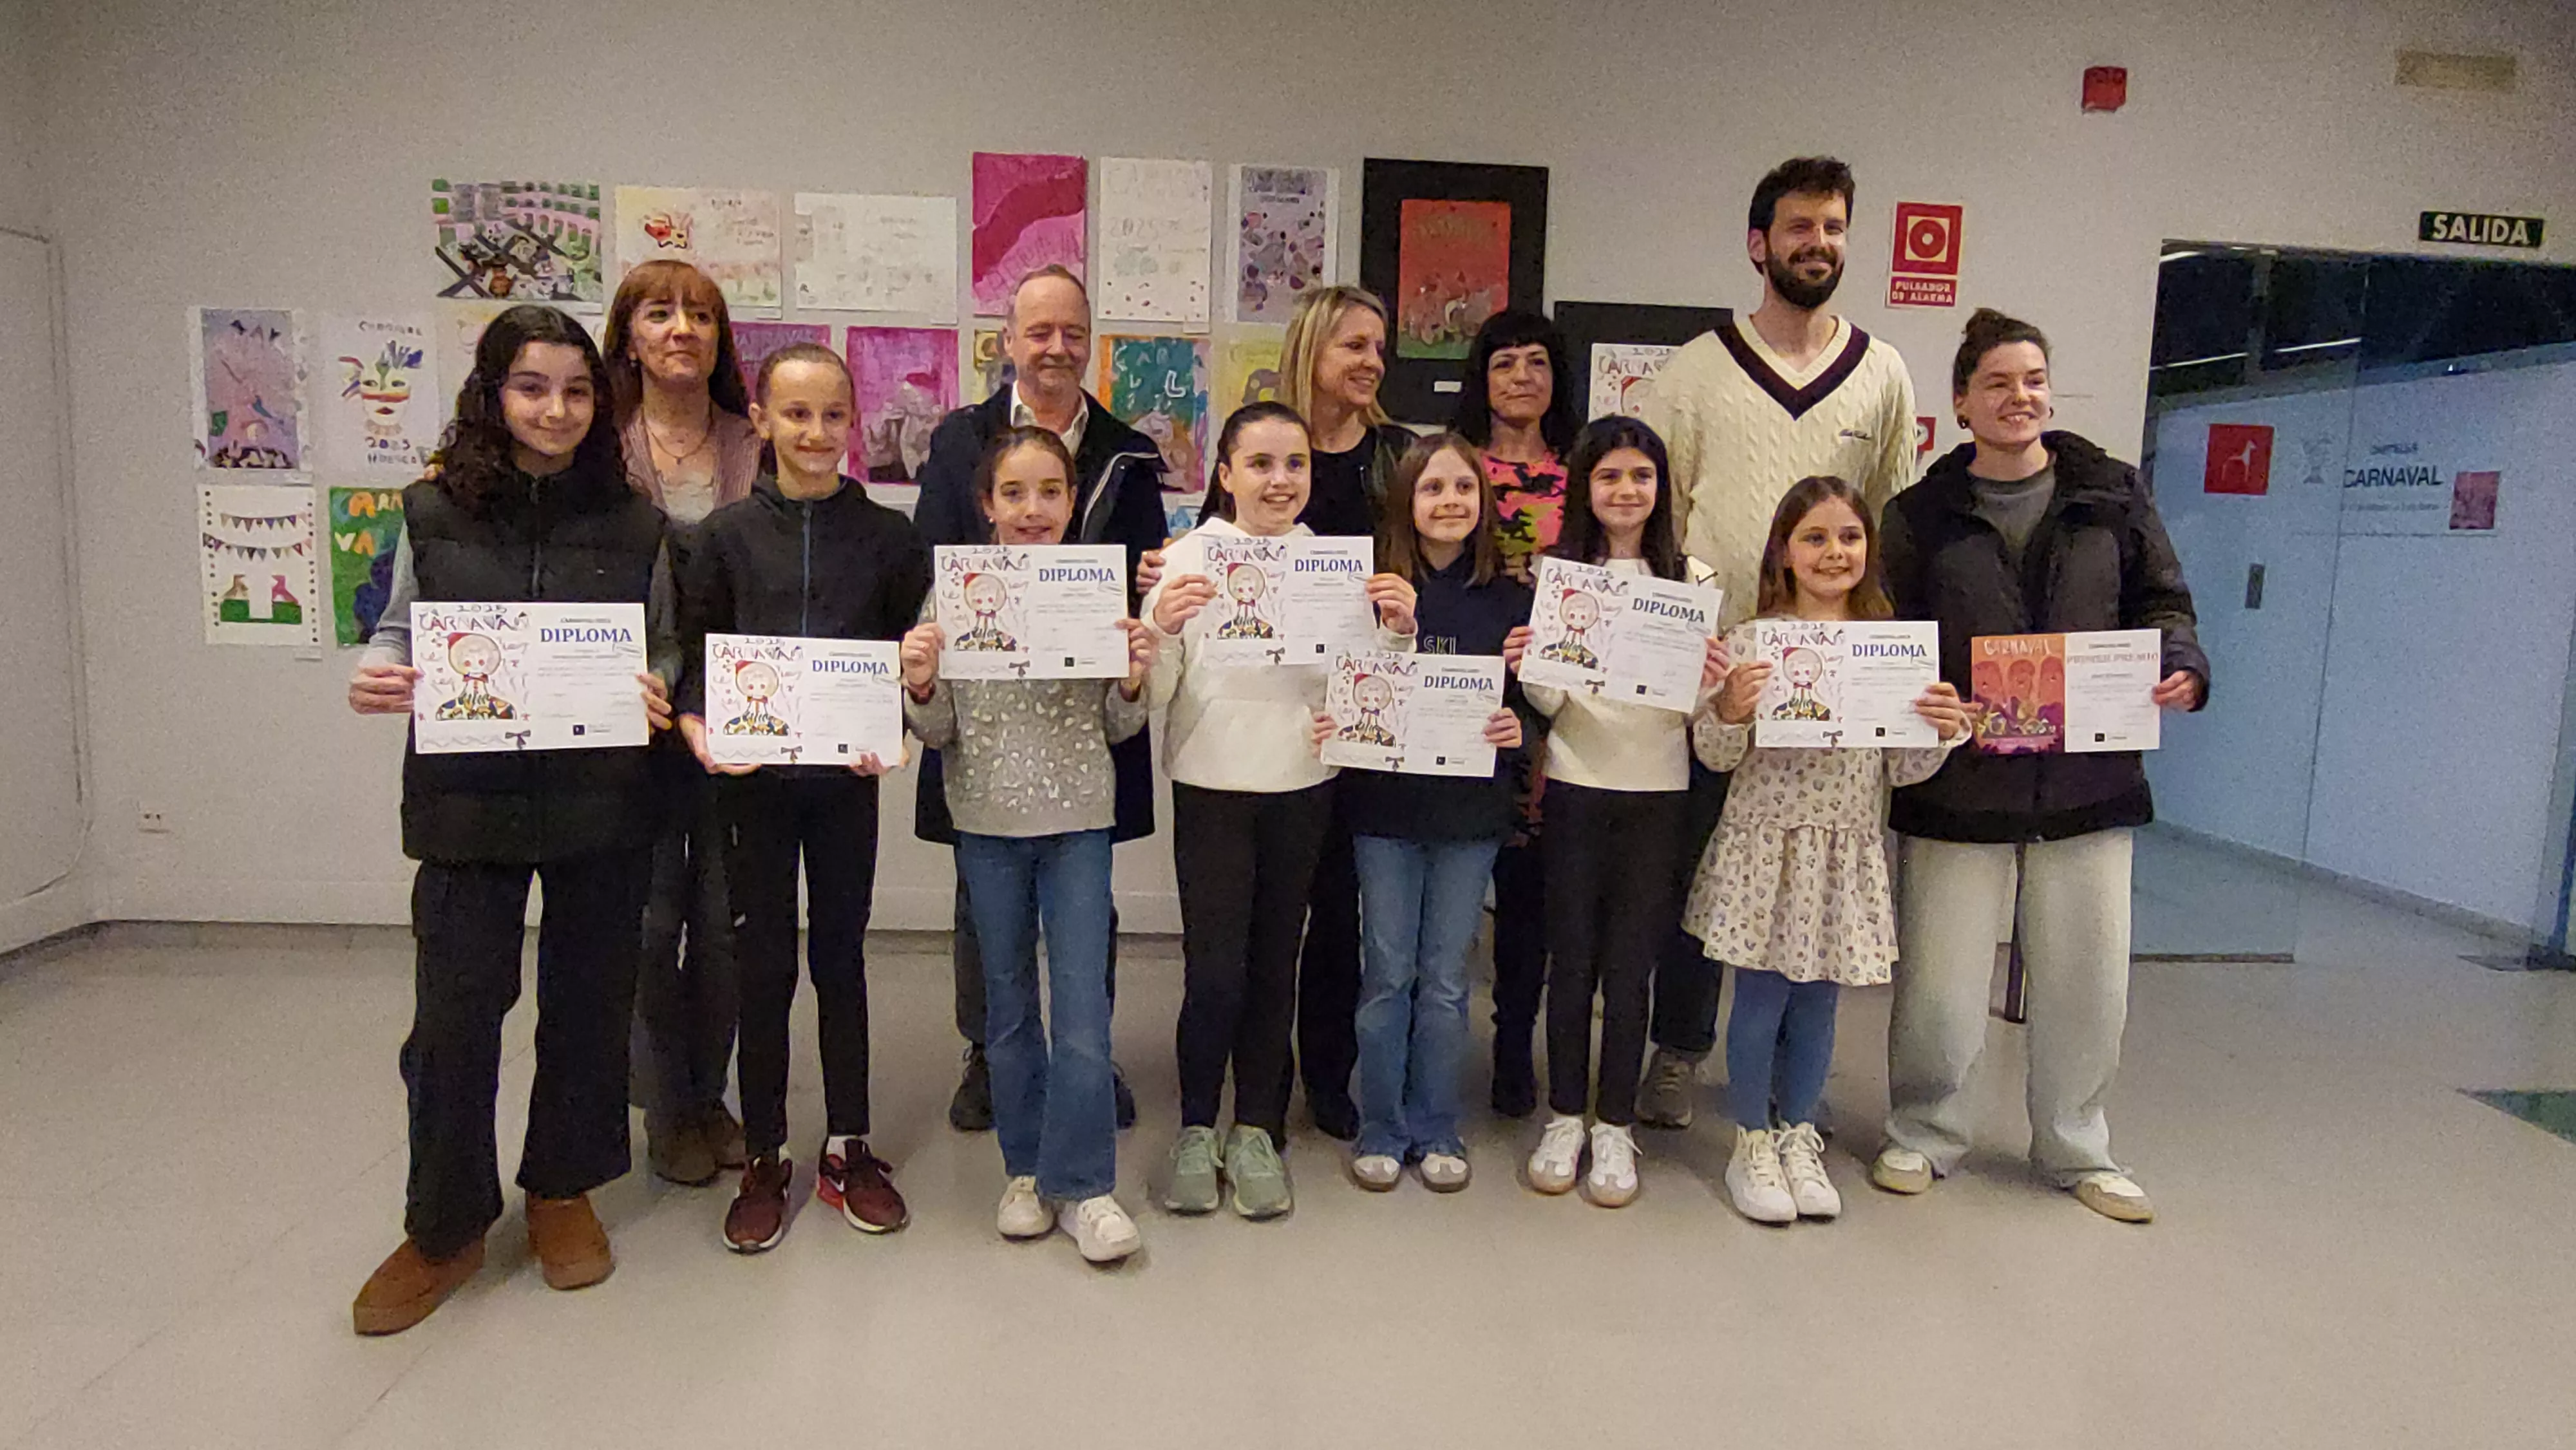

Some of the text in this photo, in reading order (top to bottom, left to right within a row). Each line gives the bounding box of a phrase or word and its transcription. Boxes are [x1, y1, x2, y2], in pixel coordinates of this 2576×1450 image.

[2432, 214, 2530, 245] SALIDA
[1895, 281, 1951, 292] PULSADOR
[1909, 292, 1953, 304] ALARMA
[2344, 466, 2445, 489] CARNAVAL
[1294, 559, 1363, 572] DIPLOMA
[1039, 568, 1115, 582] DIPLOMA
[455, 604, 507, 613] 2025
[1632, 598, 1705, 623] DIPLOMA
[540, 628, 632, 643] DIPLOMA
[1852, 644, 1927, 657] DIPLOMA
[811, 659, 889, 674] DIPLOMA
[1423, 675, 1494, 691] DIPLOMA
